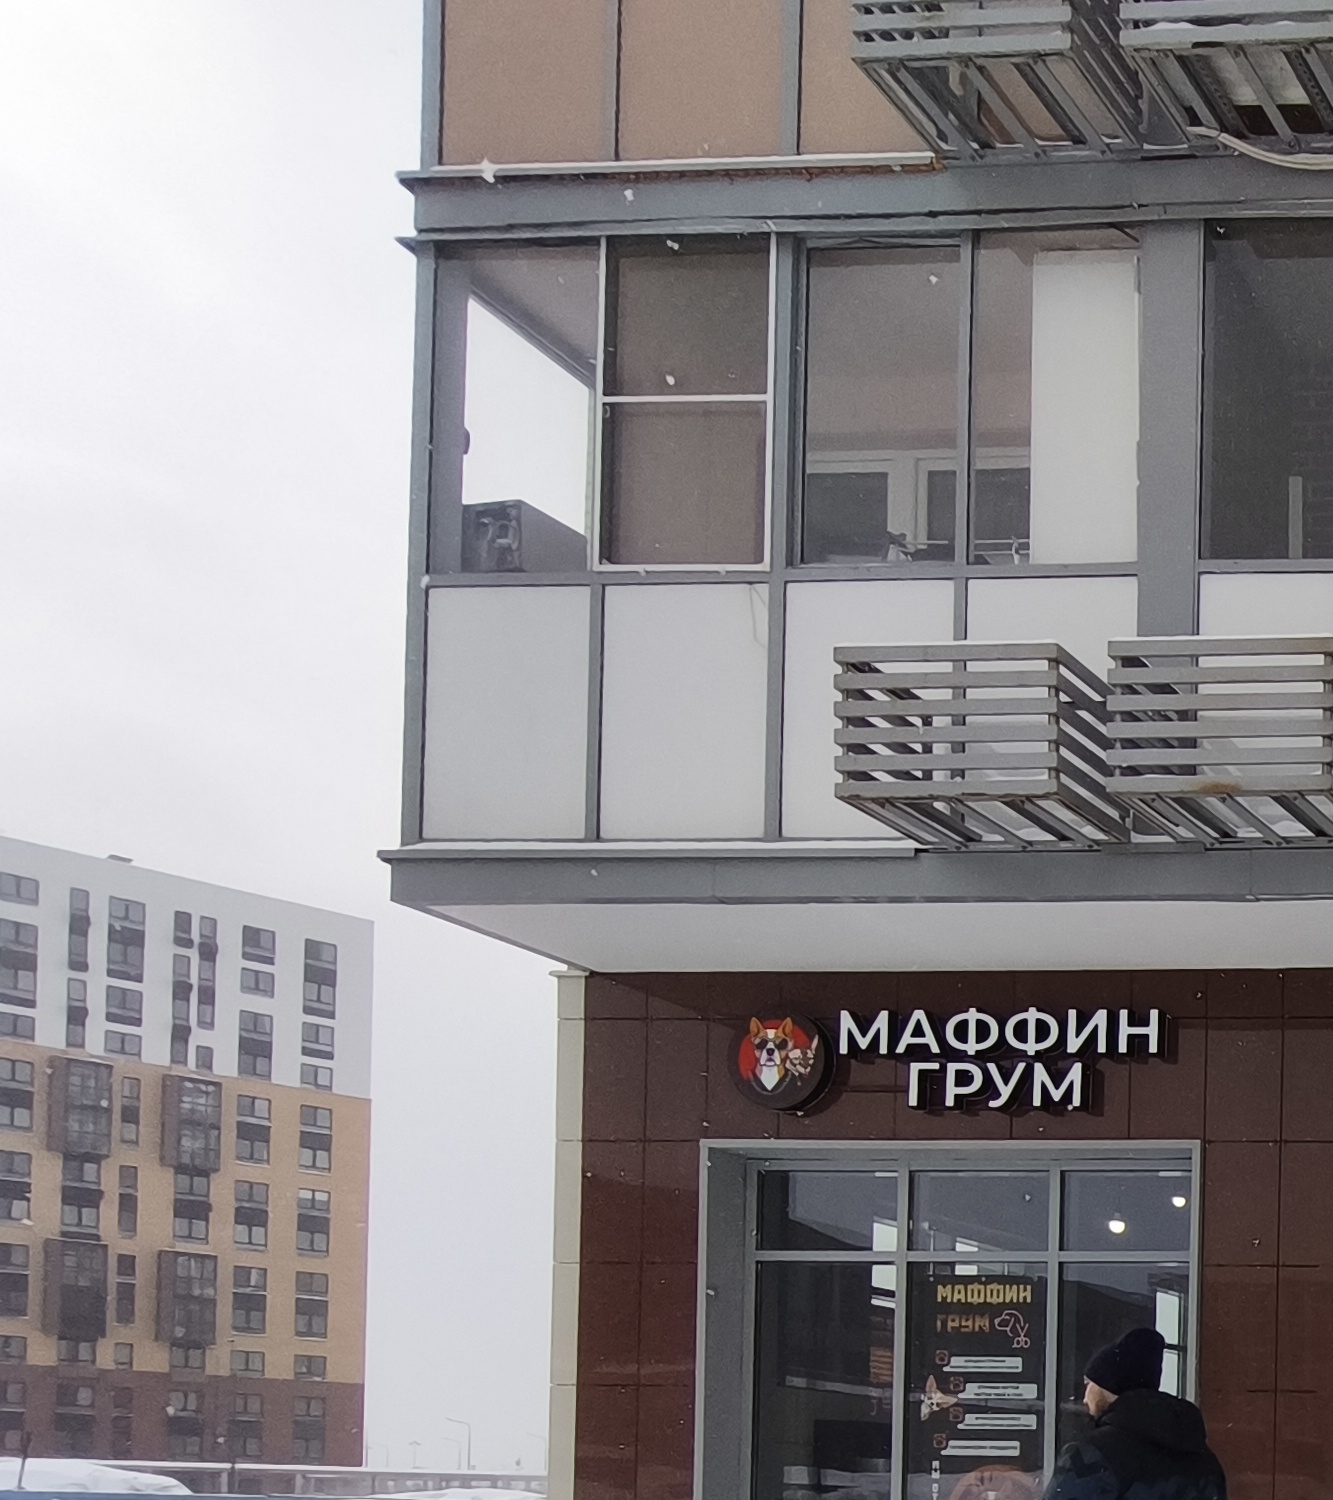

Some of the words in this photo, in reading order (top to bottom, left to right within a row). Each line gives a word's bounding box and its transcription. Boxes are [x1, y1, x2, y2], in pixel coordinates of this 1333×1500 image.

[838, 1007, 1159, 1056] МАФФИН
[908, 1061, 1083, 1108] ГРУМ
[936, 1282, 1032, 1304] МАФФИН
[936, 1313, 990, 1332] ГРУМ
